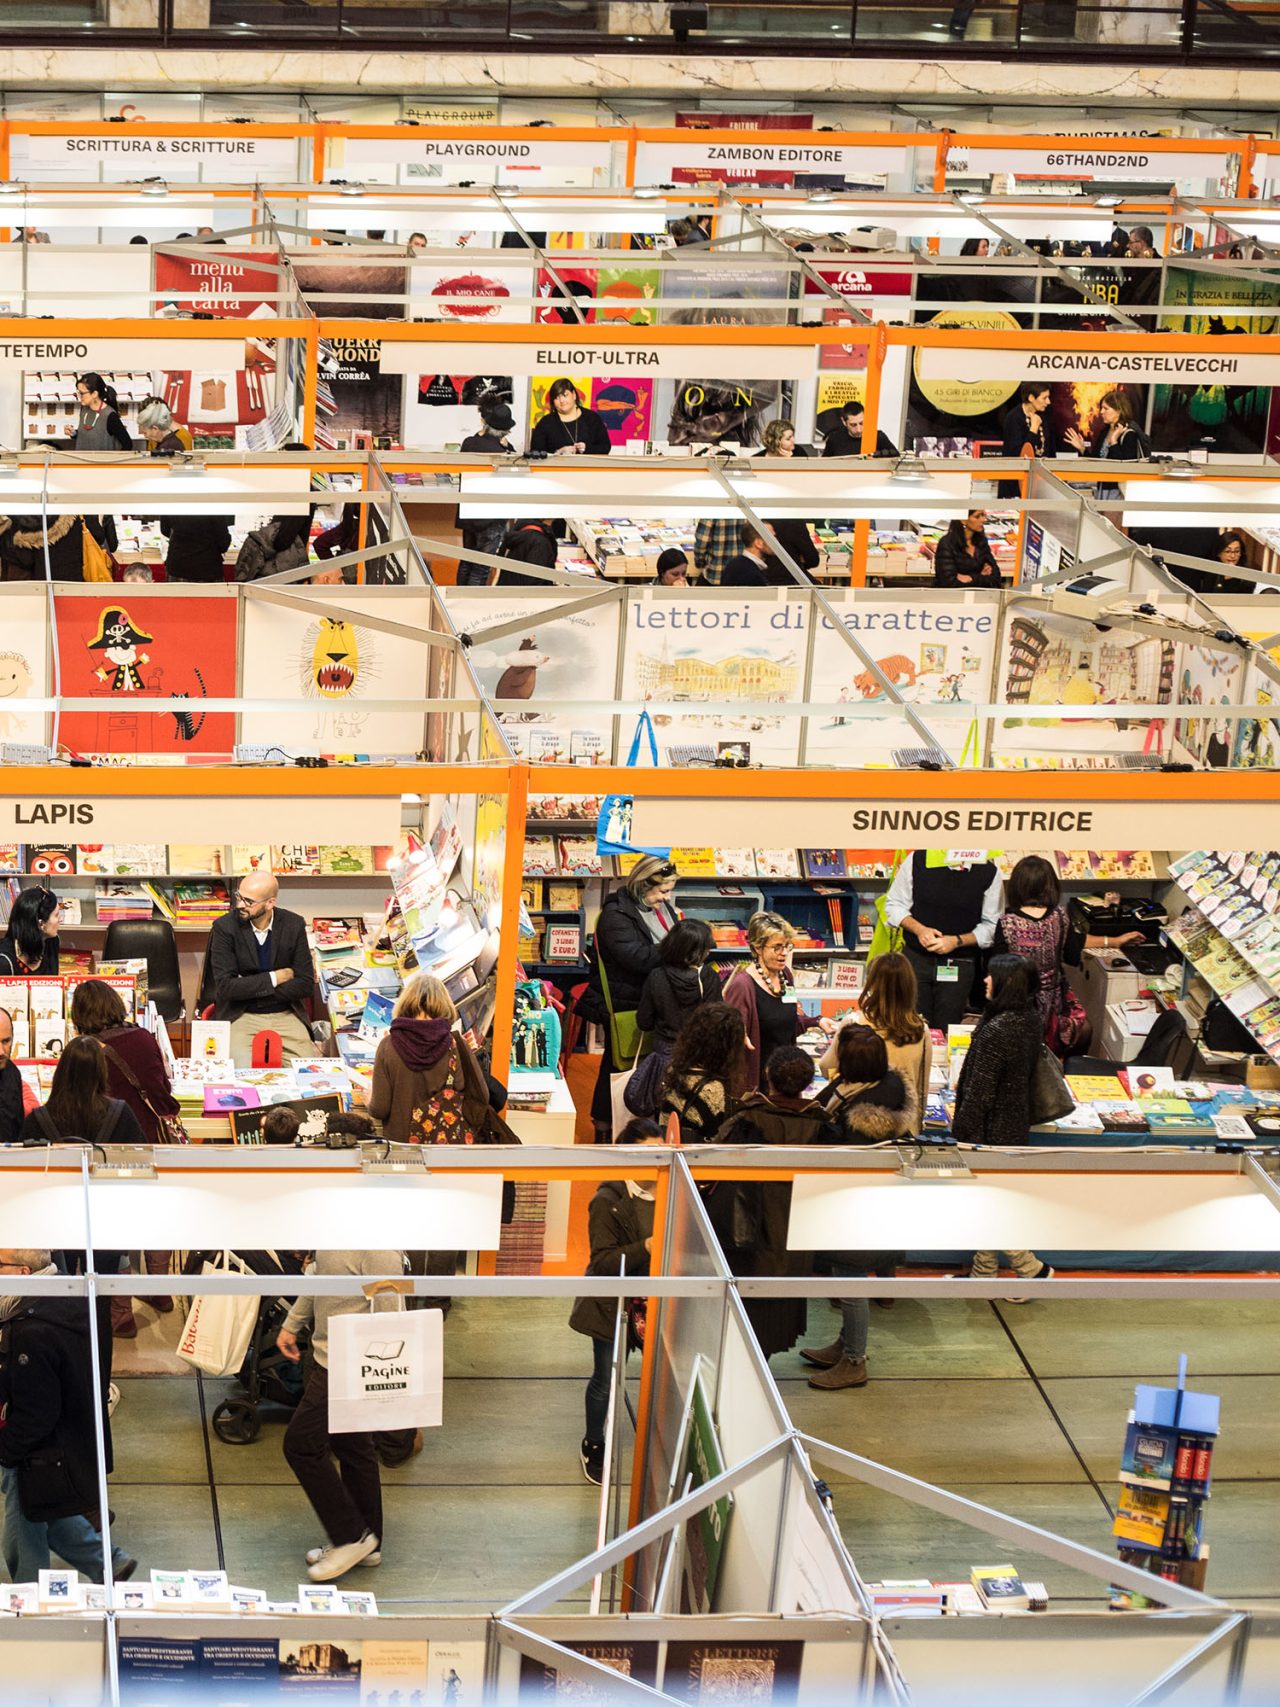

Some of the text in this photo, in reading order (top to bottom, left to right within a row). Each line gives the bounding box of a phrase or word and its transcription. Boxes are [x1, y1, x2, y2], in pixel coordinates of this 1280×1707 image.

[66, 139, 255, 153] SCRITTURA & SCRITTURE
[426, 144, 530, 156] PLAYGROUND
[707, 148, 842, 162] ZAMBON EDITORE
[1046, 154, 1149, 167] 66THAND2ND
[190, 262, 245, 276] menu
[199, 276, 234, 293] alla
[831, 283, 873, 292] arcana
[331, 339, 381, 349] UERR
[331, 348, 381, 360] MOND
[536, 350, 660, 365] ELLIOT-ULTRA
[1026, 354, 1238, 374] ARCANA-CASTELVECCHI
[634, 603, 992, 633] lettori di carattere
[14, 803, 94, 825] LAPIS
[852, 809, 1093, 832] SINNOS EDITRICE
[558, 946, 576, 954] EURO
[586, 1647, 634, 1658] TTERE
